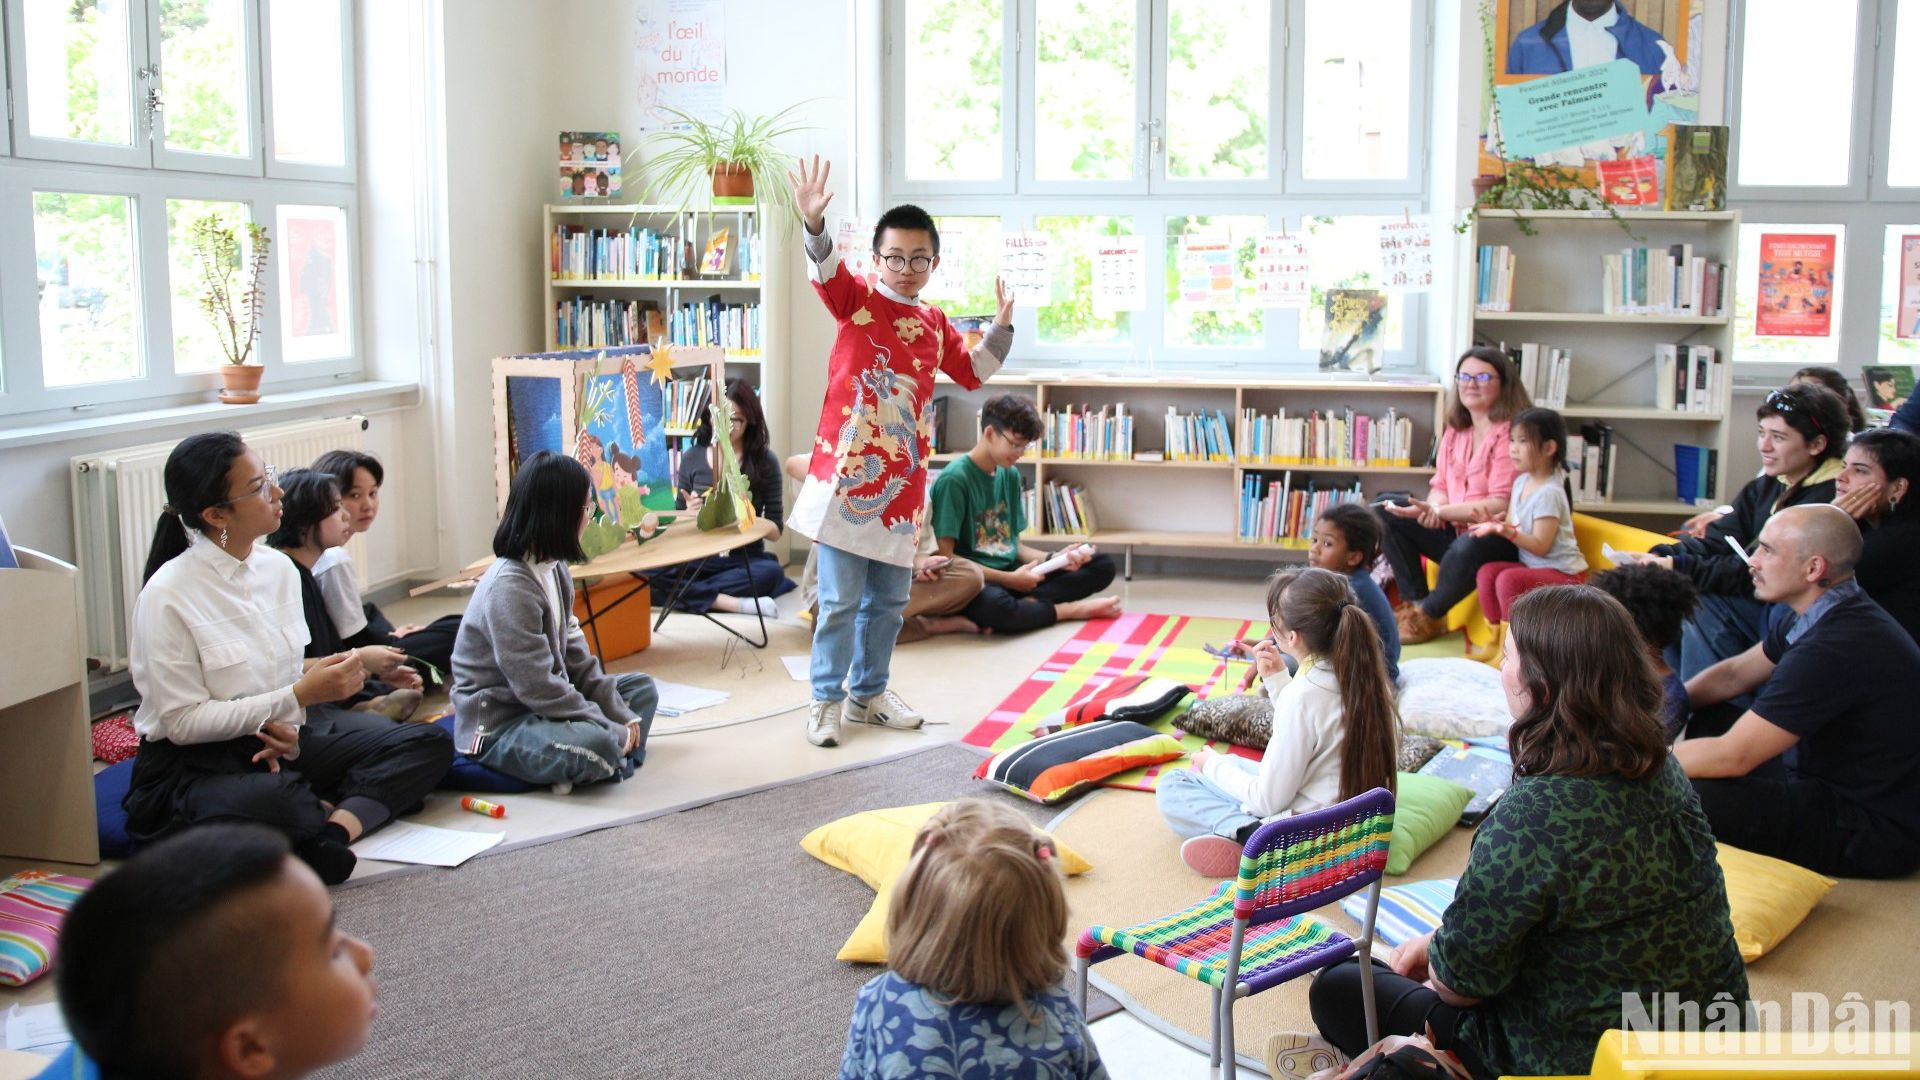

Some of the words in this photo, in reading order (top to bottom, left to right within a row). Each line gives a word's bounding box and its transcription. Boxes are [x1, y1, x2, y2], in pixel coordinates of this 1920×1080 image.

[668, 20, 703, 40] l'œil
[661, 45, 682, 62] du
[657, 65, 719, 84] monde
[1520, 82, 1549, 94] Festival
[1528, 91, 1560, 105] Grande
[1564, 82, 1608, 97] rencontre
[1539, 102, 1559, 112] avec
